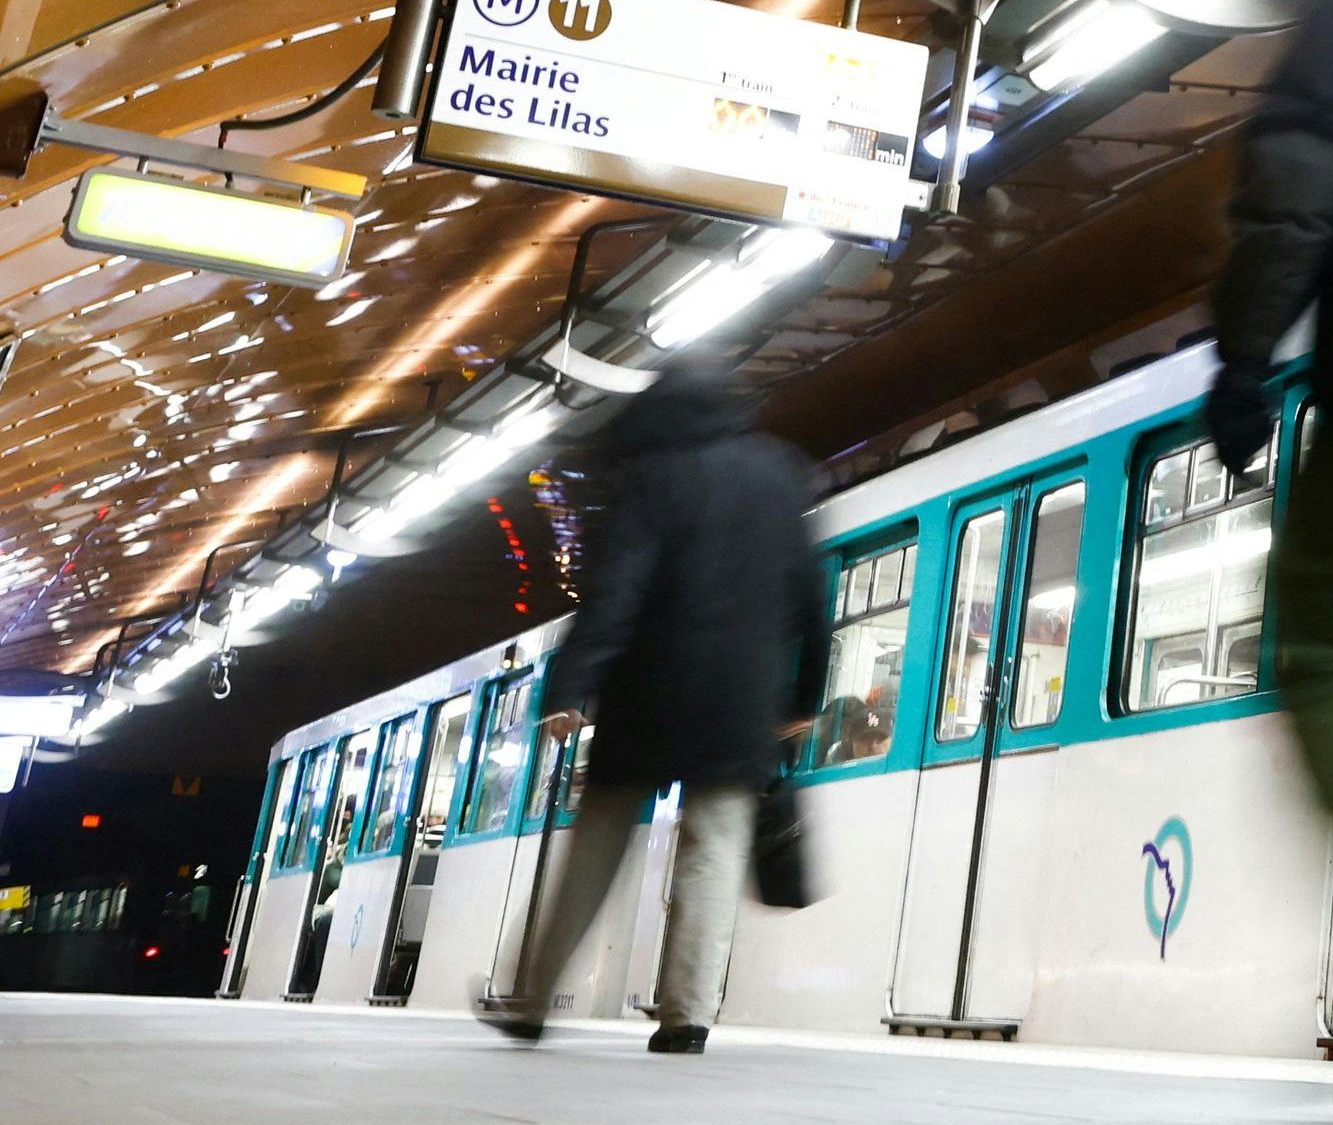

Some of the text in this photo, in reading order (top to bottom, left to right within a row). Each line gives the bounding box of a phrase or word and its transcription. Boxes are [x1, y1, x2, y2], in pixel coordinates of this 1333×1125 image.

[459, 45, 580, 93] Mairie
[741, 78, 774, 94] train
[450, 84, 611, 138] des Lilas
[876, 148, 905, 166] min
